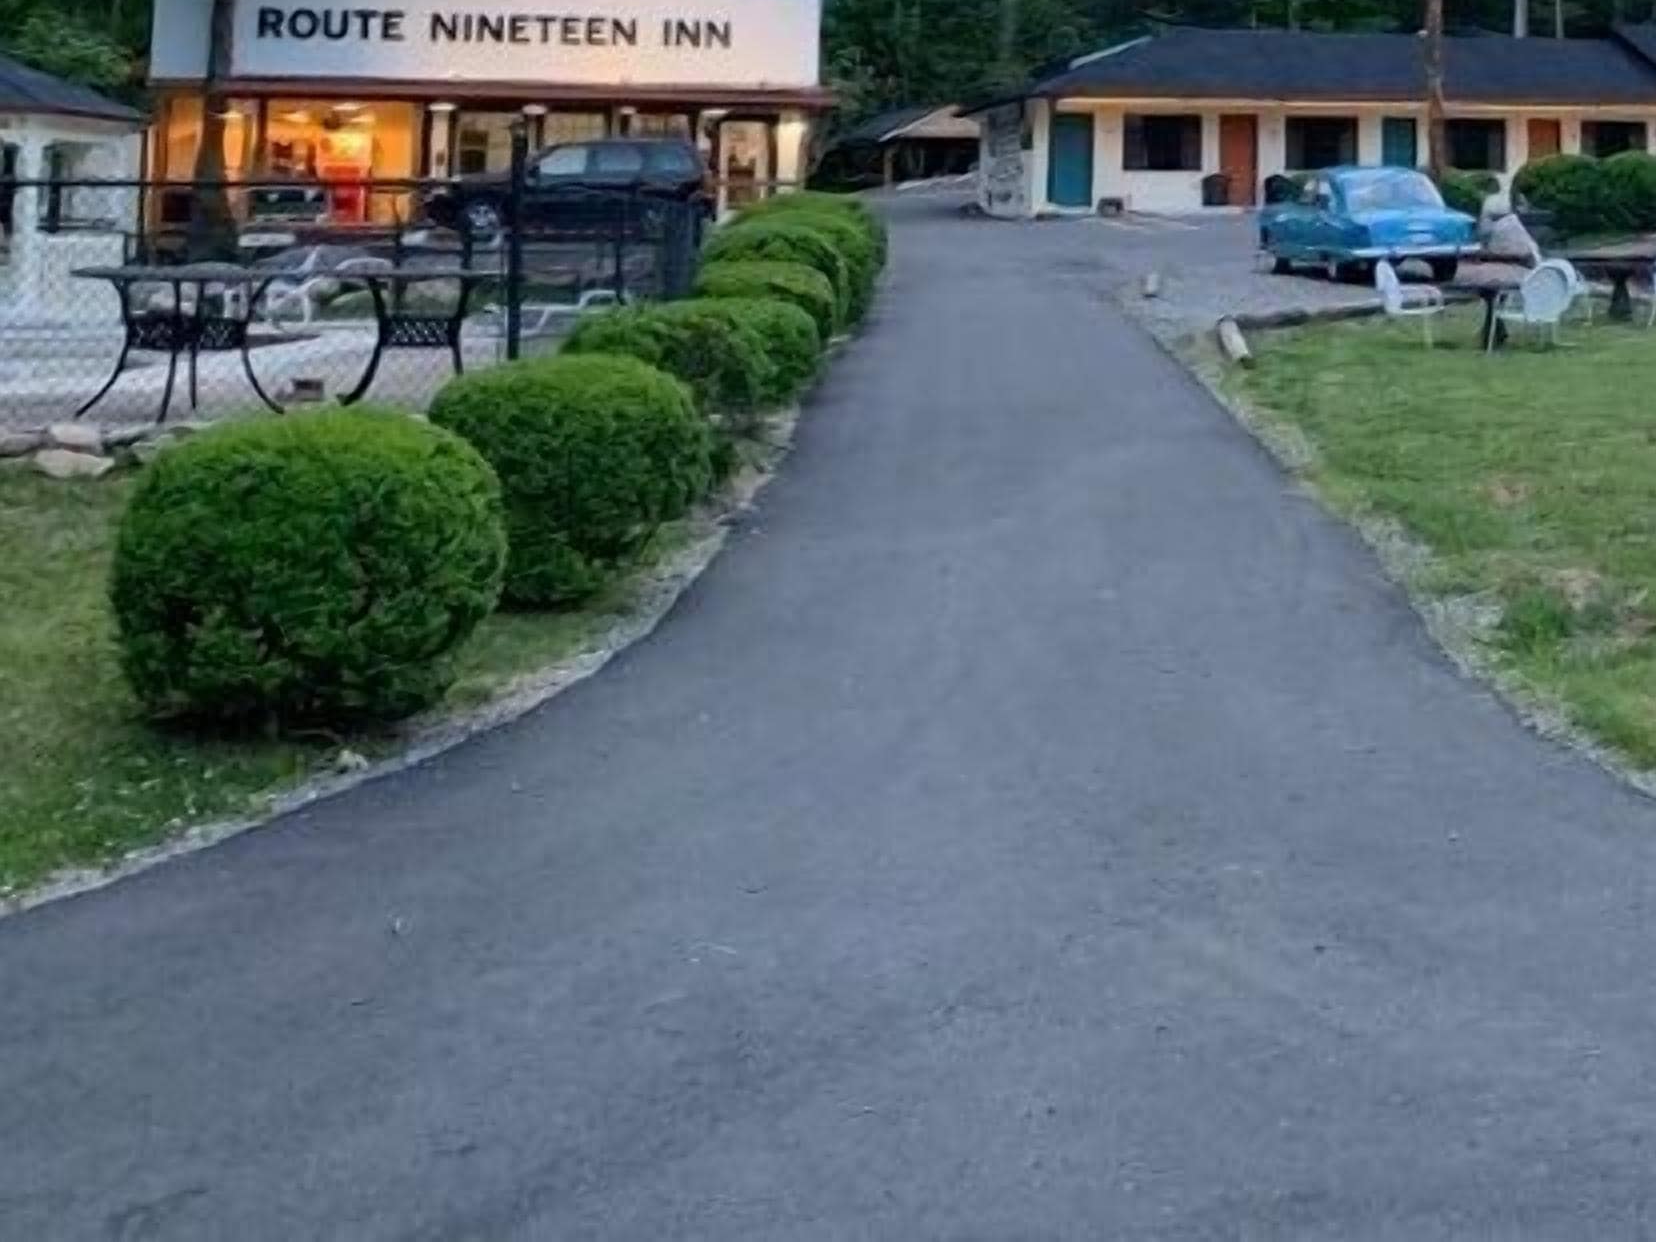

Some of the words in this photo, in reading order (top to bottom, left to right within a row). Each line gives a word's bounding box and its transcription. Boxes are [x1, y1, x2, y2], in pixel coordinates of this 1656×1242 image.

[257, 6, 405, 41] ROUTE
[430, 12, 637, 47] NINETEEN
[662, 17, 732, 49] INN
